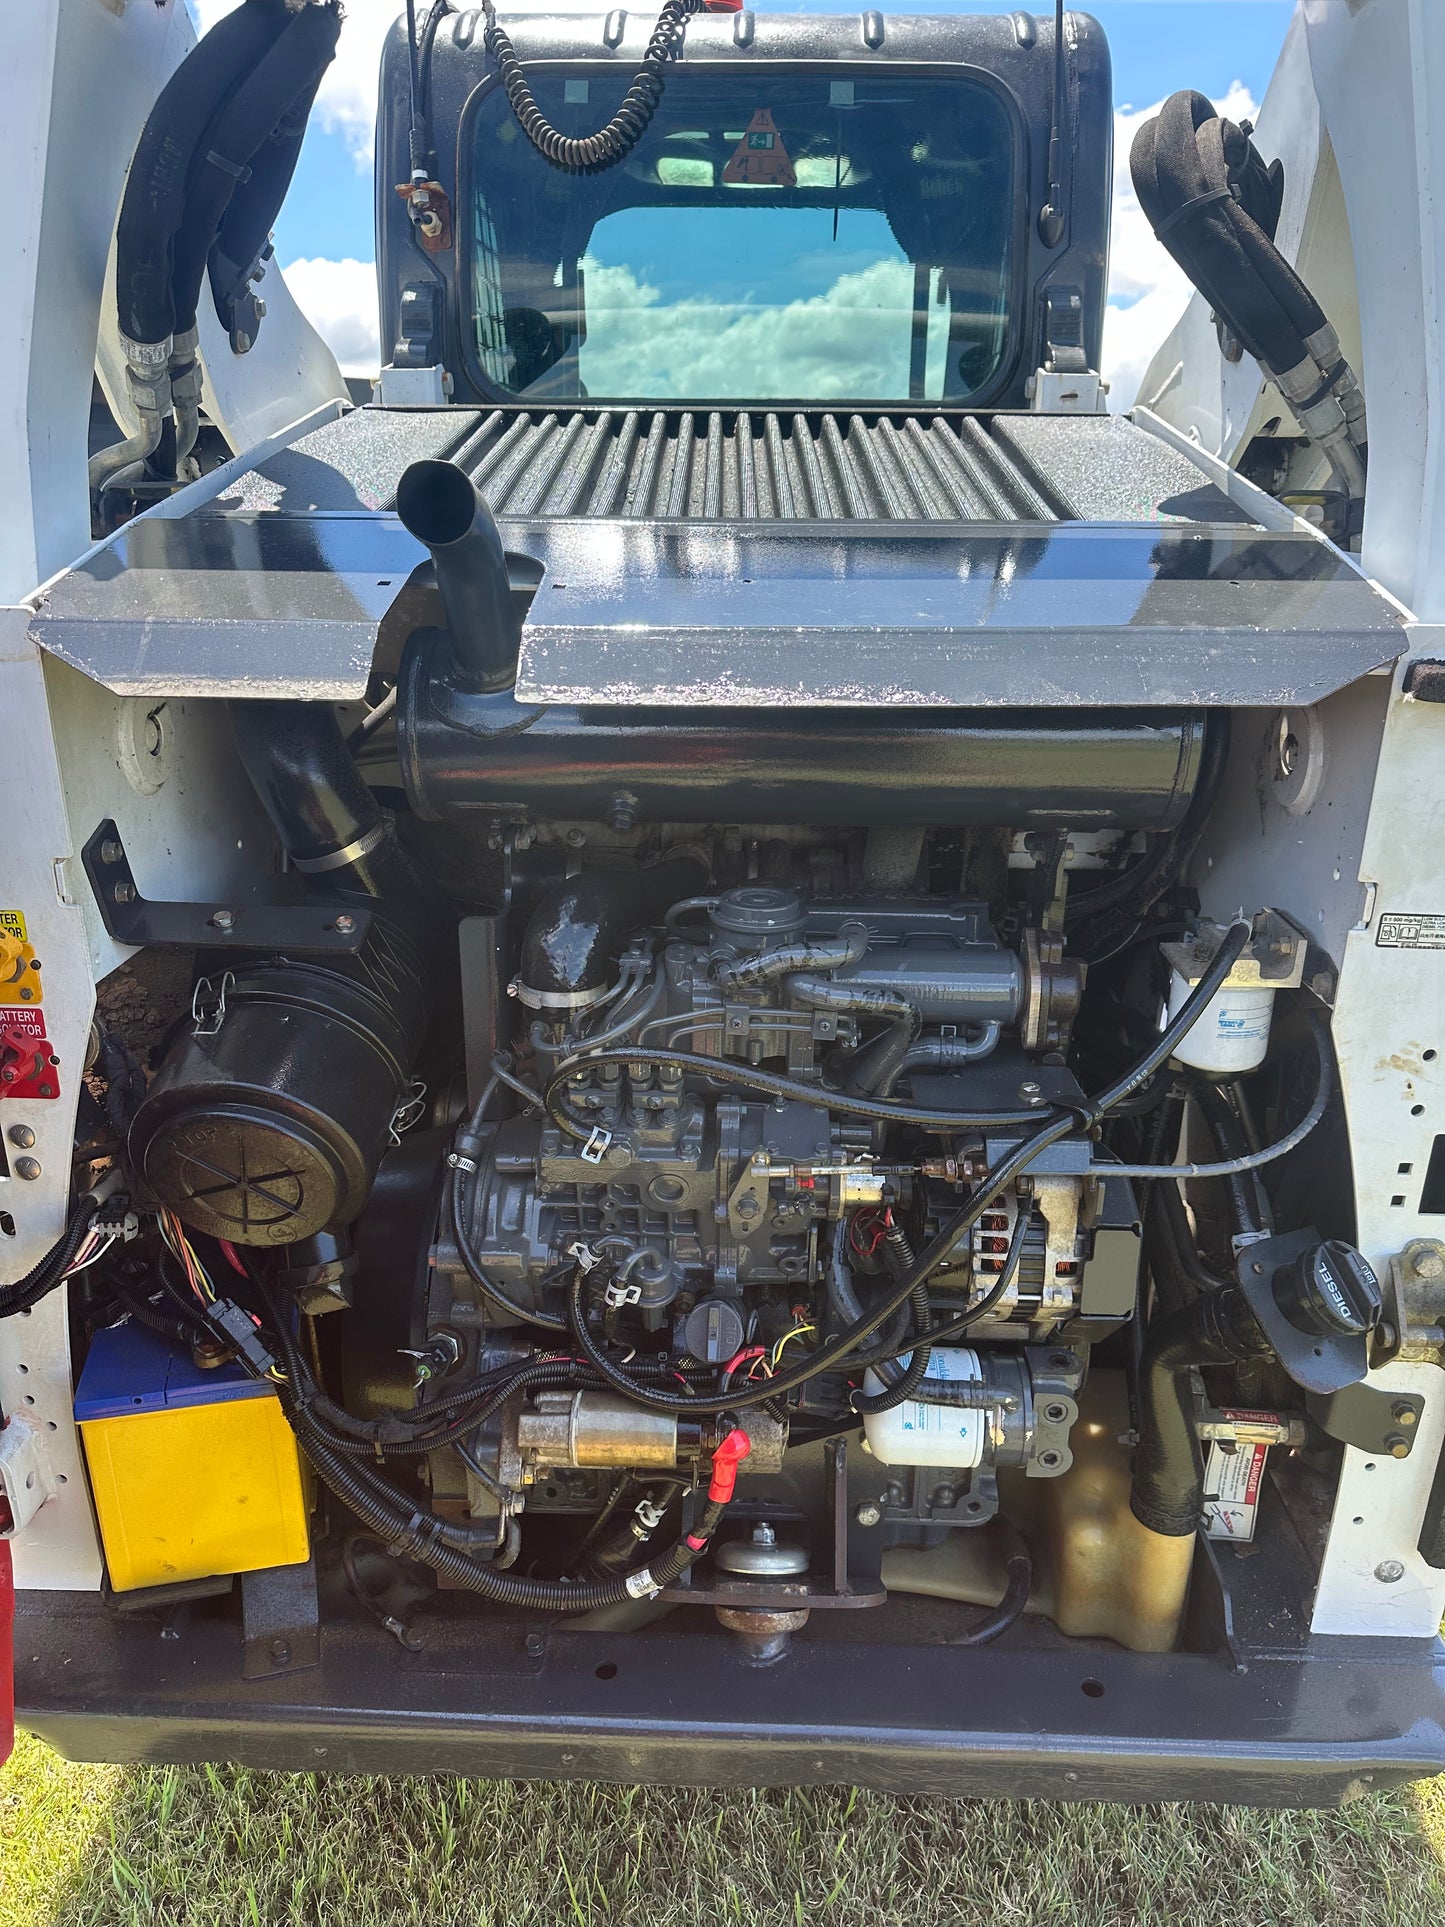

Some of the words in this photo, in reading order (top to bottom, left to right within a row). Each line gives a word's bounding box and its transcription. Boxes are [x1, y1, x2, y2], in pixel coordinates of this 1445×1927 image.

[1318, 1262, 1352, 1318] DIESEL
[1236, 1412, 1278, 1423] DANGER
[1247, 1460, 1262, 1492] DANGER
